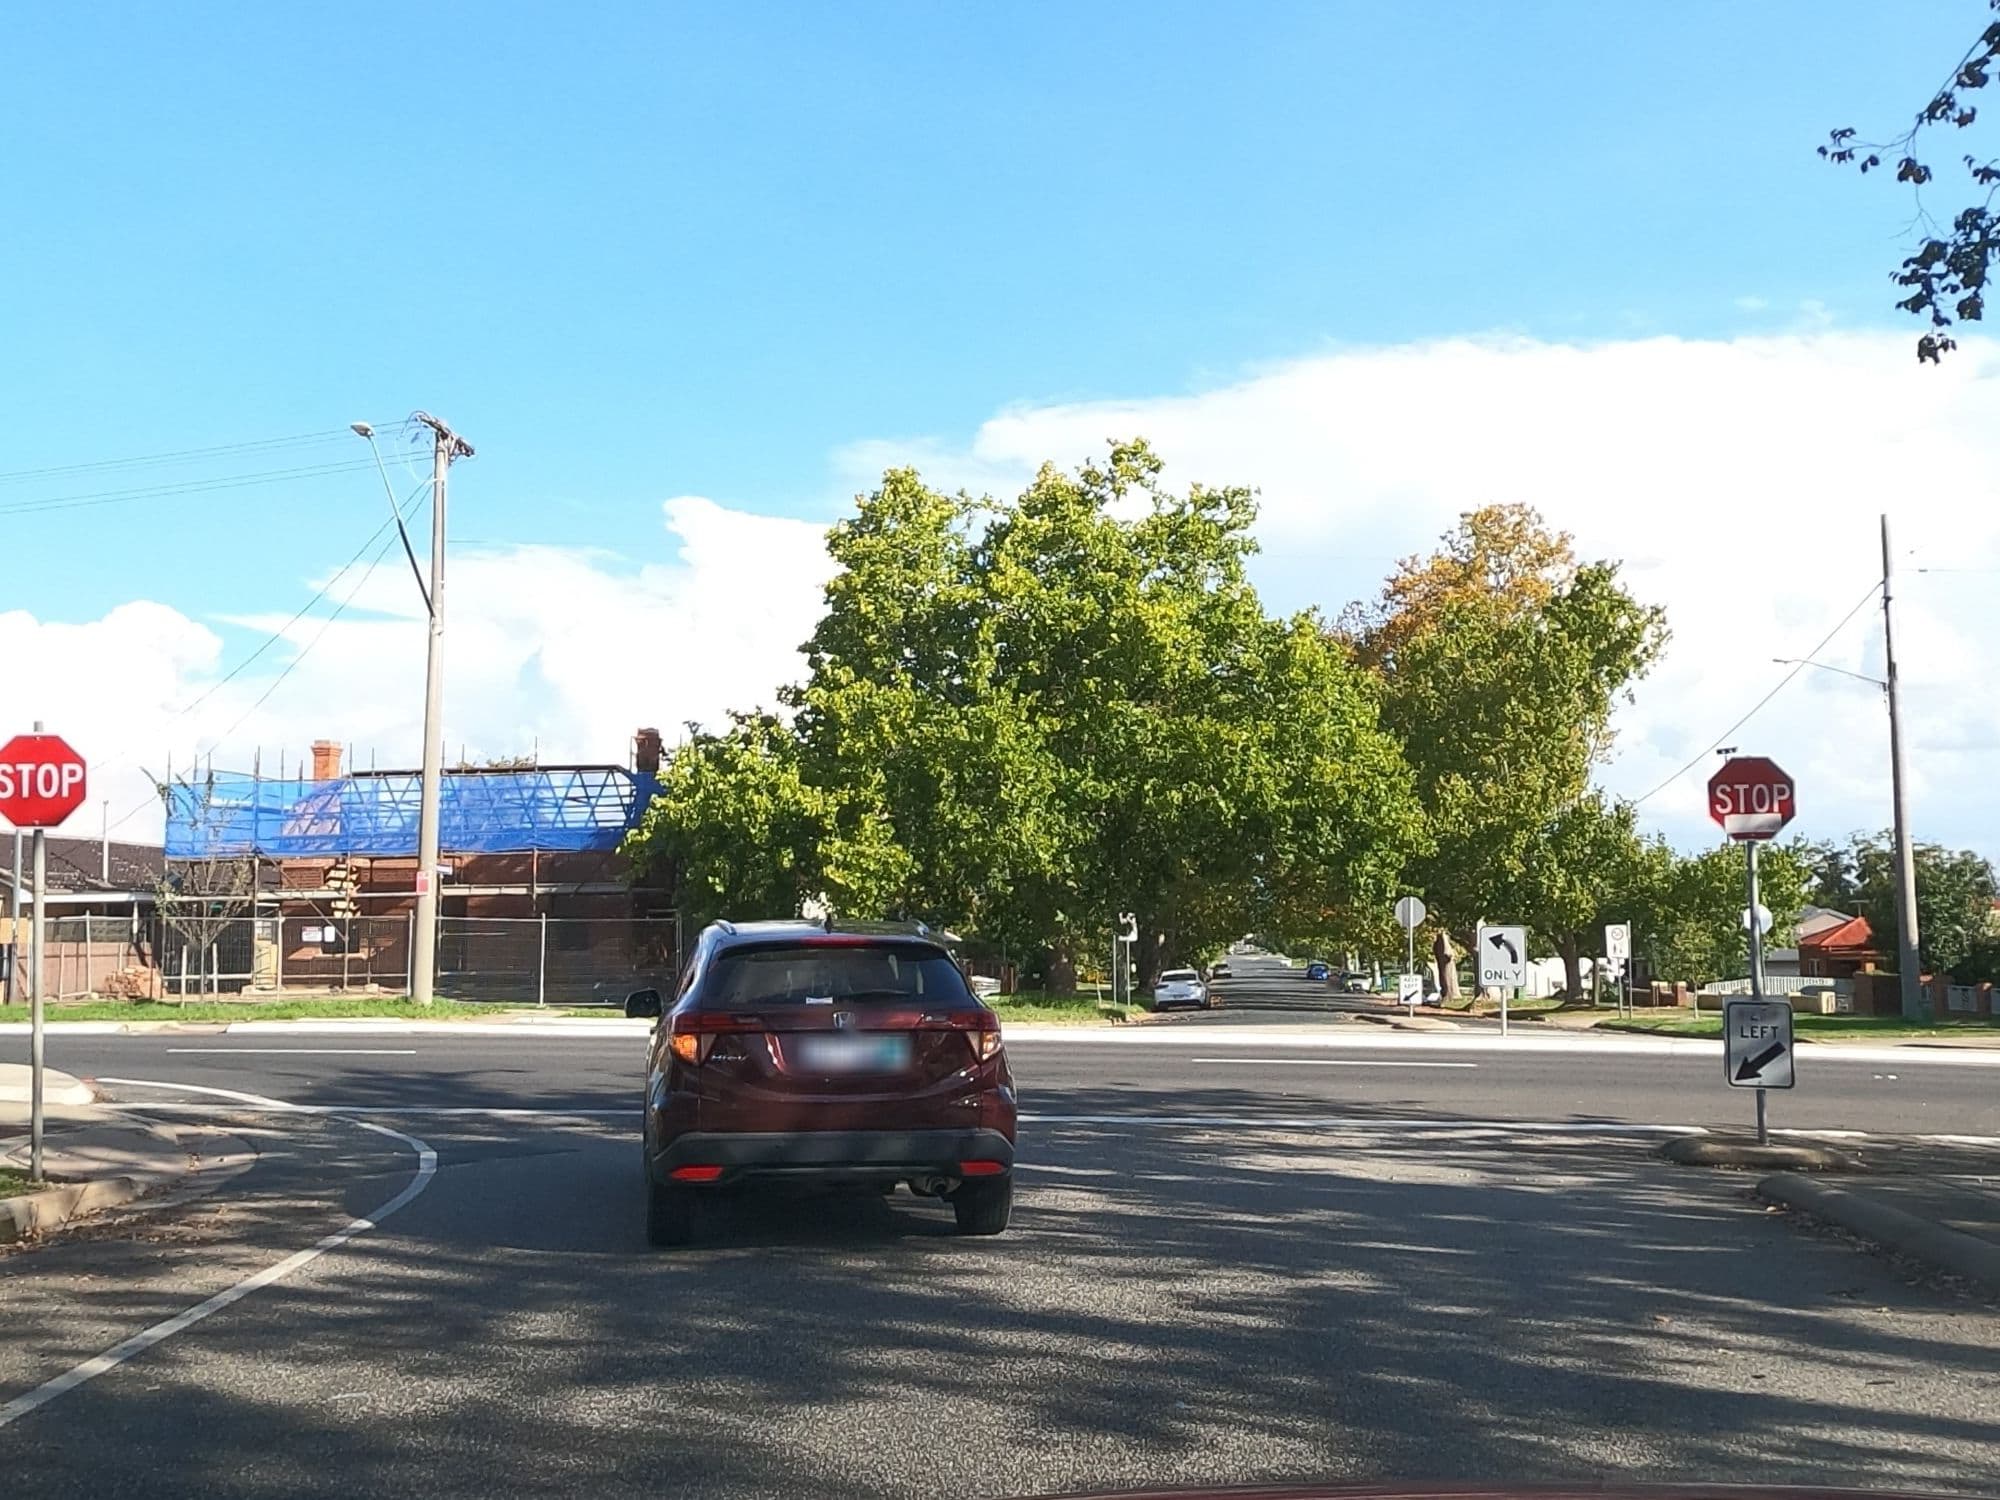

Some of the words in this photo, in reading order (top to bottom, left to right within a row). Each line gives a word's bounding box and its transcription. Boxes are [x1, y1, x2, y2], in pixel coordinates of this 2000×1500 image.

[0, 763, 83, 799] STOP
[1715, 783, 1791, 814] STOP
[1484, 969, 1521, 981] ONLY
[1740, 1025, 1779, 1039] LEFT
